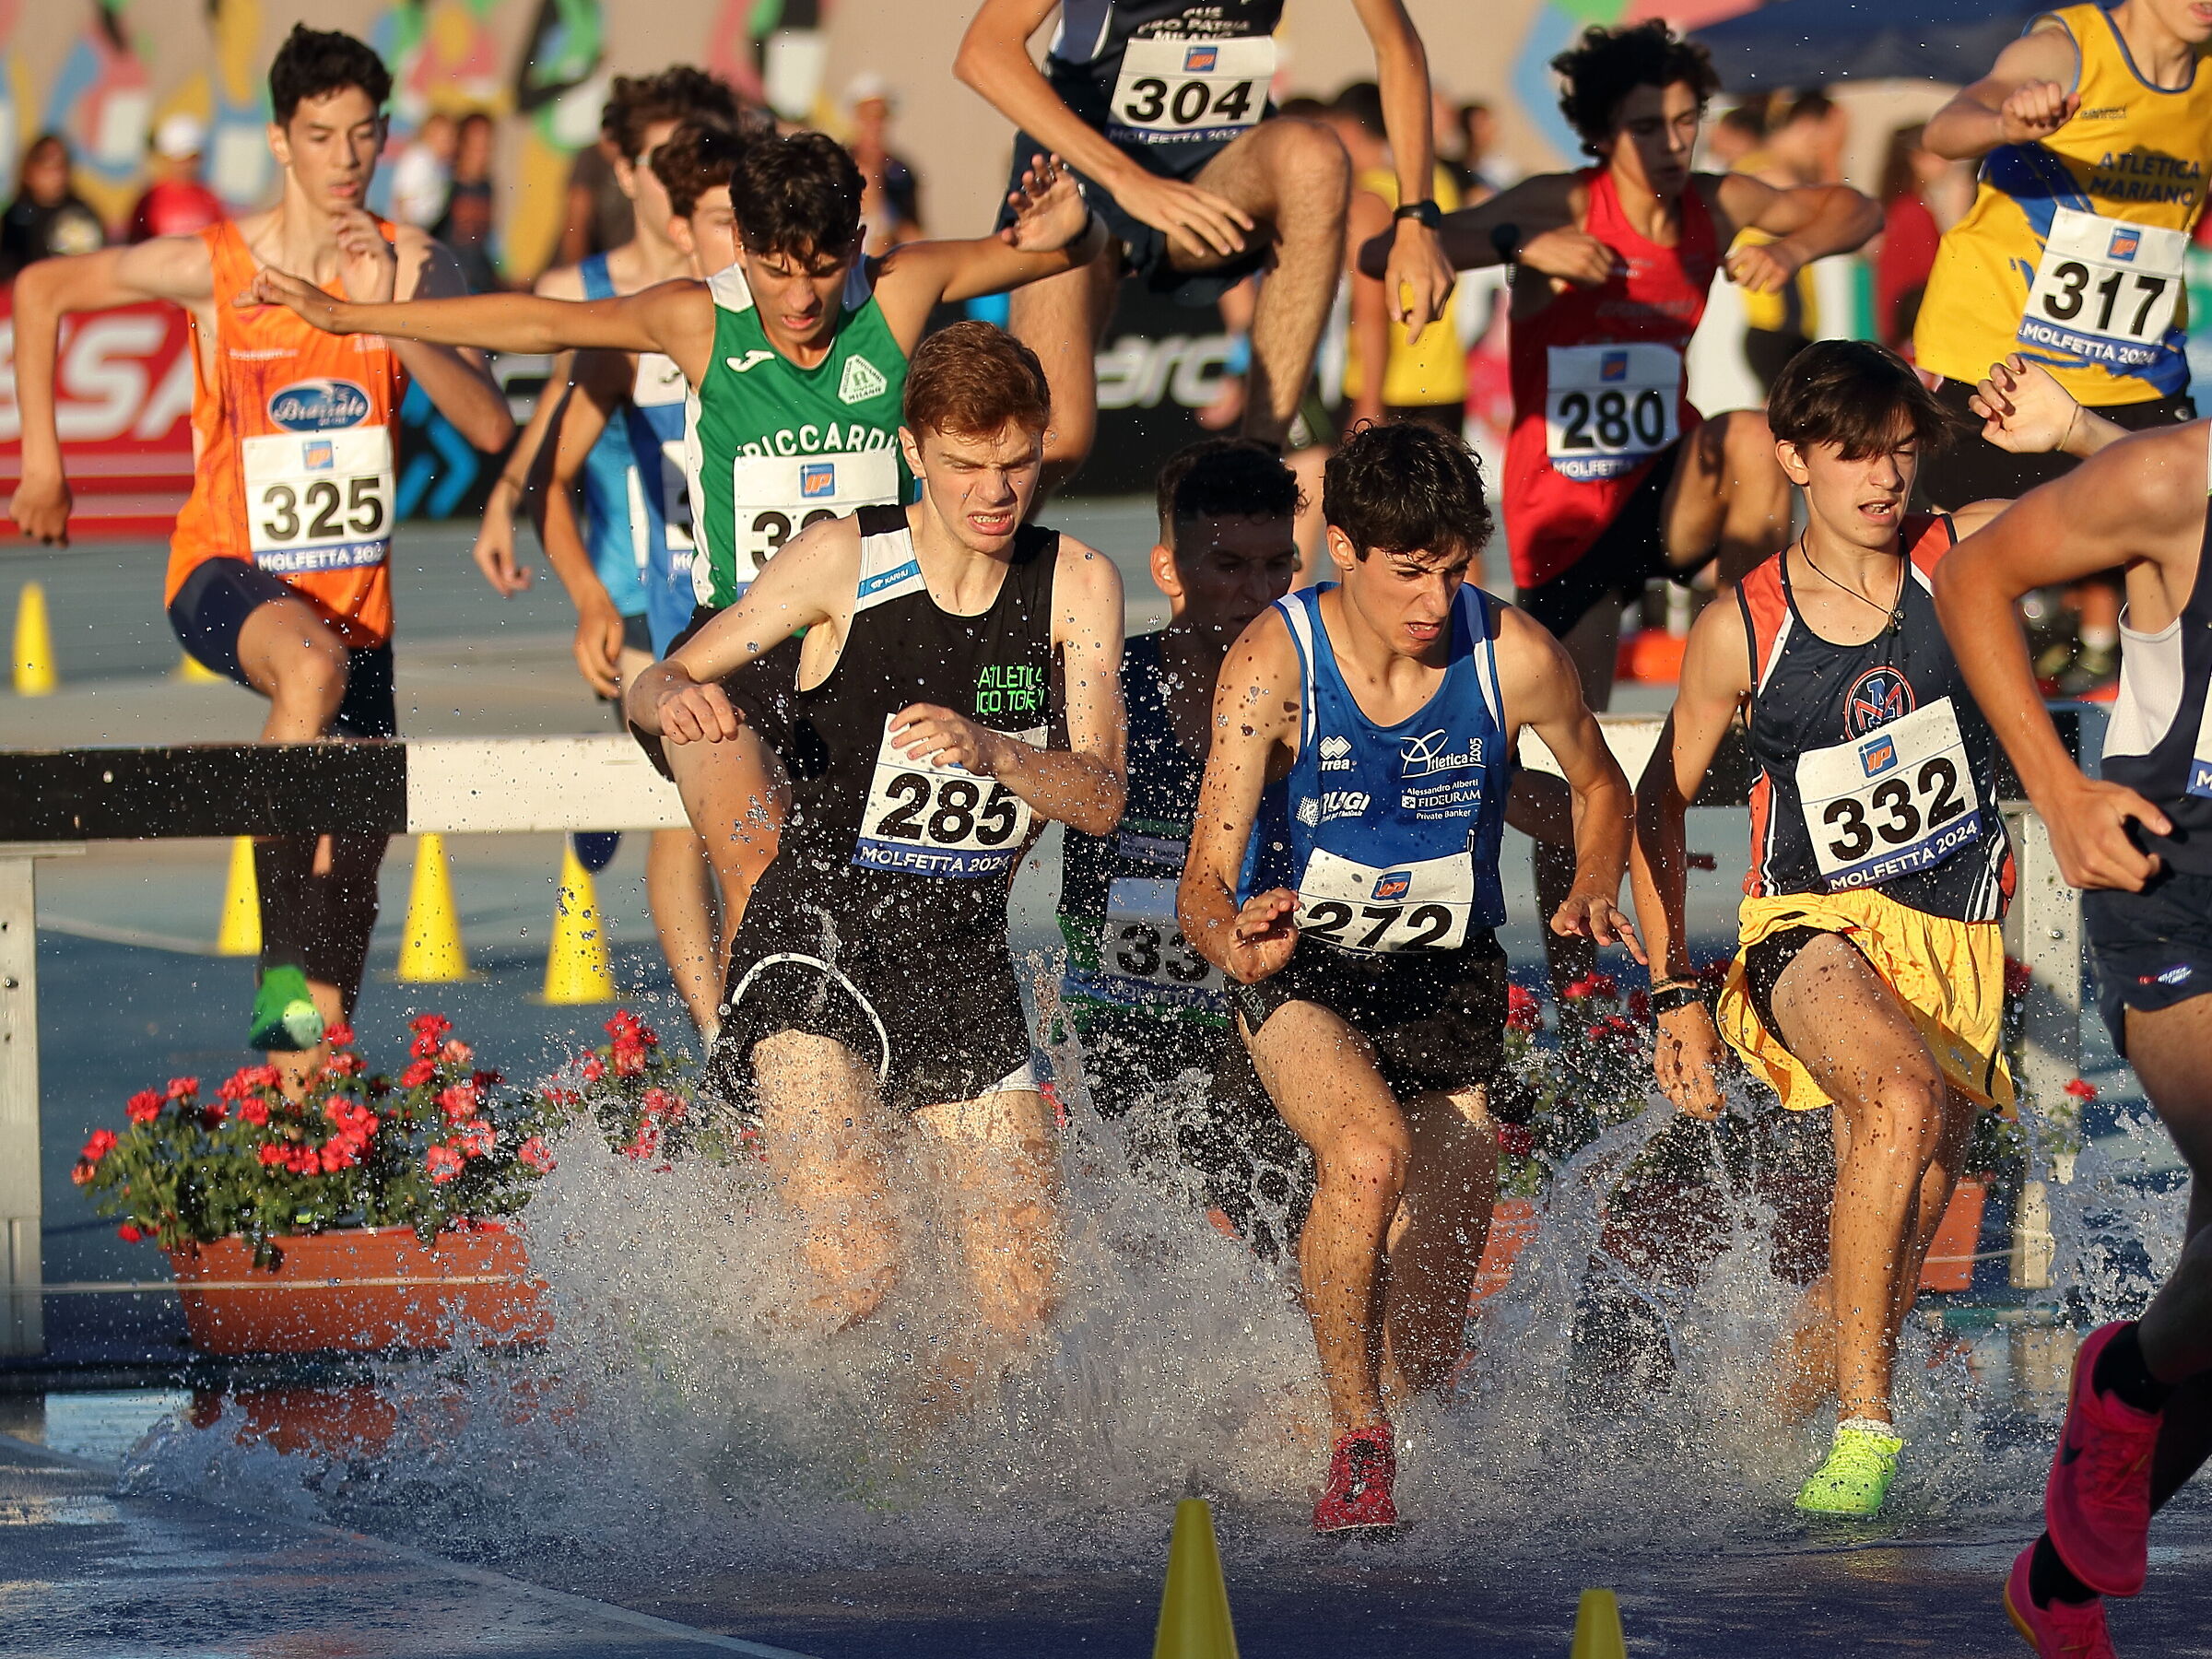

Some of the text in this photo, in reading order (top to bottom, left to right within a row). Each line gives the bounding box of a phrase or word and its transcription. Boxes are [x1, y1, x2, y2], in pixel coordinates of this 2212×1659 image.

[1126, 77, 1253, 124] 304
[2098, 152, 2201, 180] ATLETICA
[2089, 176, 2196, 206] MARIANO
[2043, 260, 2168, 336] 317
[2023, 323, 2116, 362] MOLFETTA
[1559, 388, 1665, 449] 280
[264, 477, 383, 542] 325
[257, 547, 351, 571] MOLFETTA
[885, 568, 909, 585] KARHU
[1469, 737, 1483, 763] 2005
[1406, 778, 1479, 796] Alessandro Alberti
[1418, 789, 1482, 807] FIDEURAM
[875, 772, 1018, 846] 285
[1416, 808, 1472, 820] Private Banker
[1823, 757, 1966, 862] 332
[861, 845, 965, 873] MOLFETTA
[1830, 819, 1978, 890] MOLFETTA 2024
[1299, 900, 1453, 952] 272
